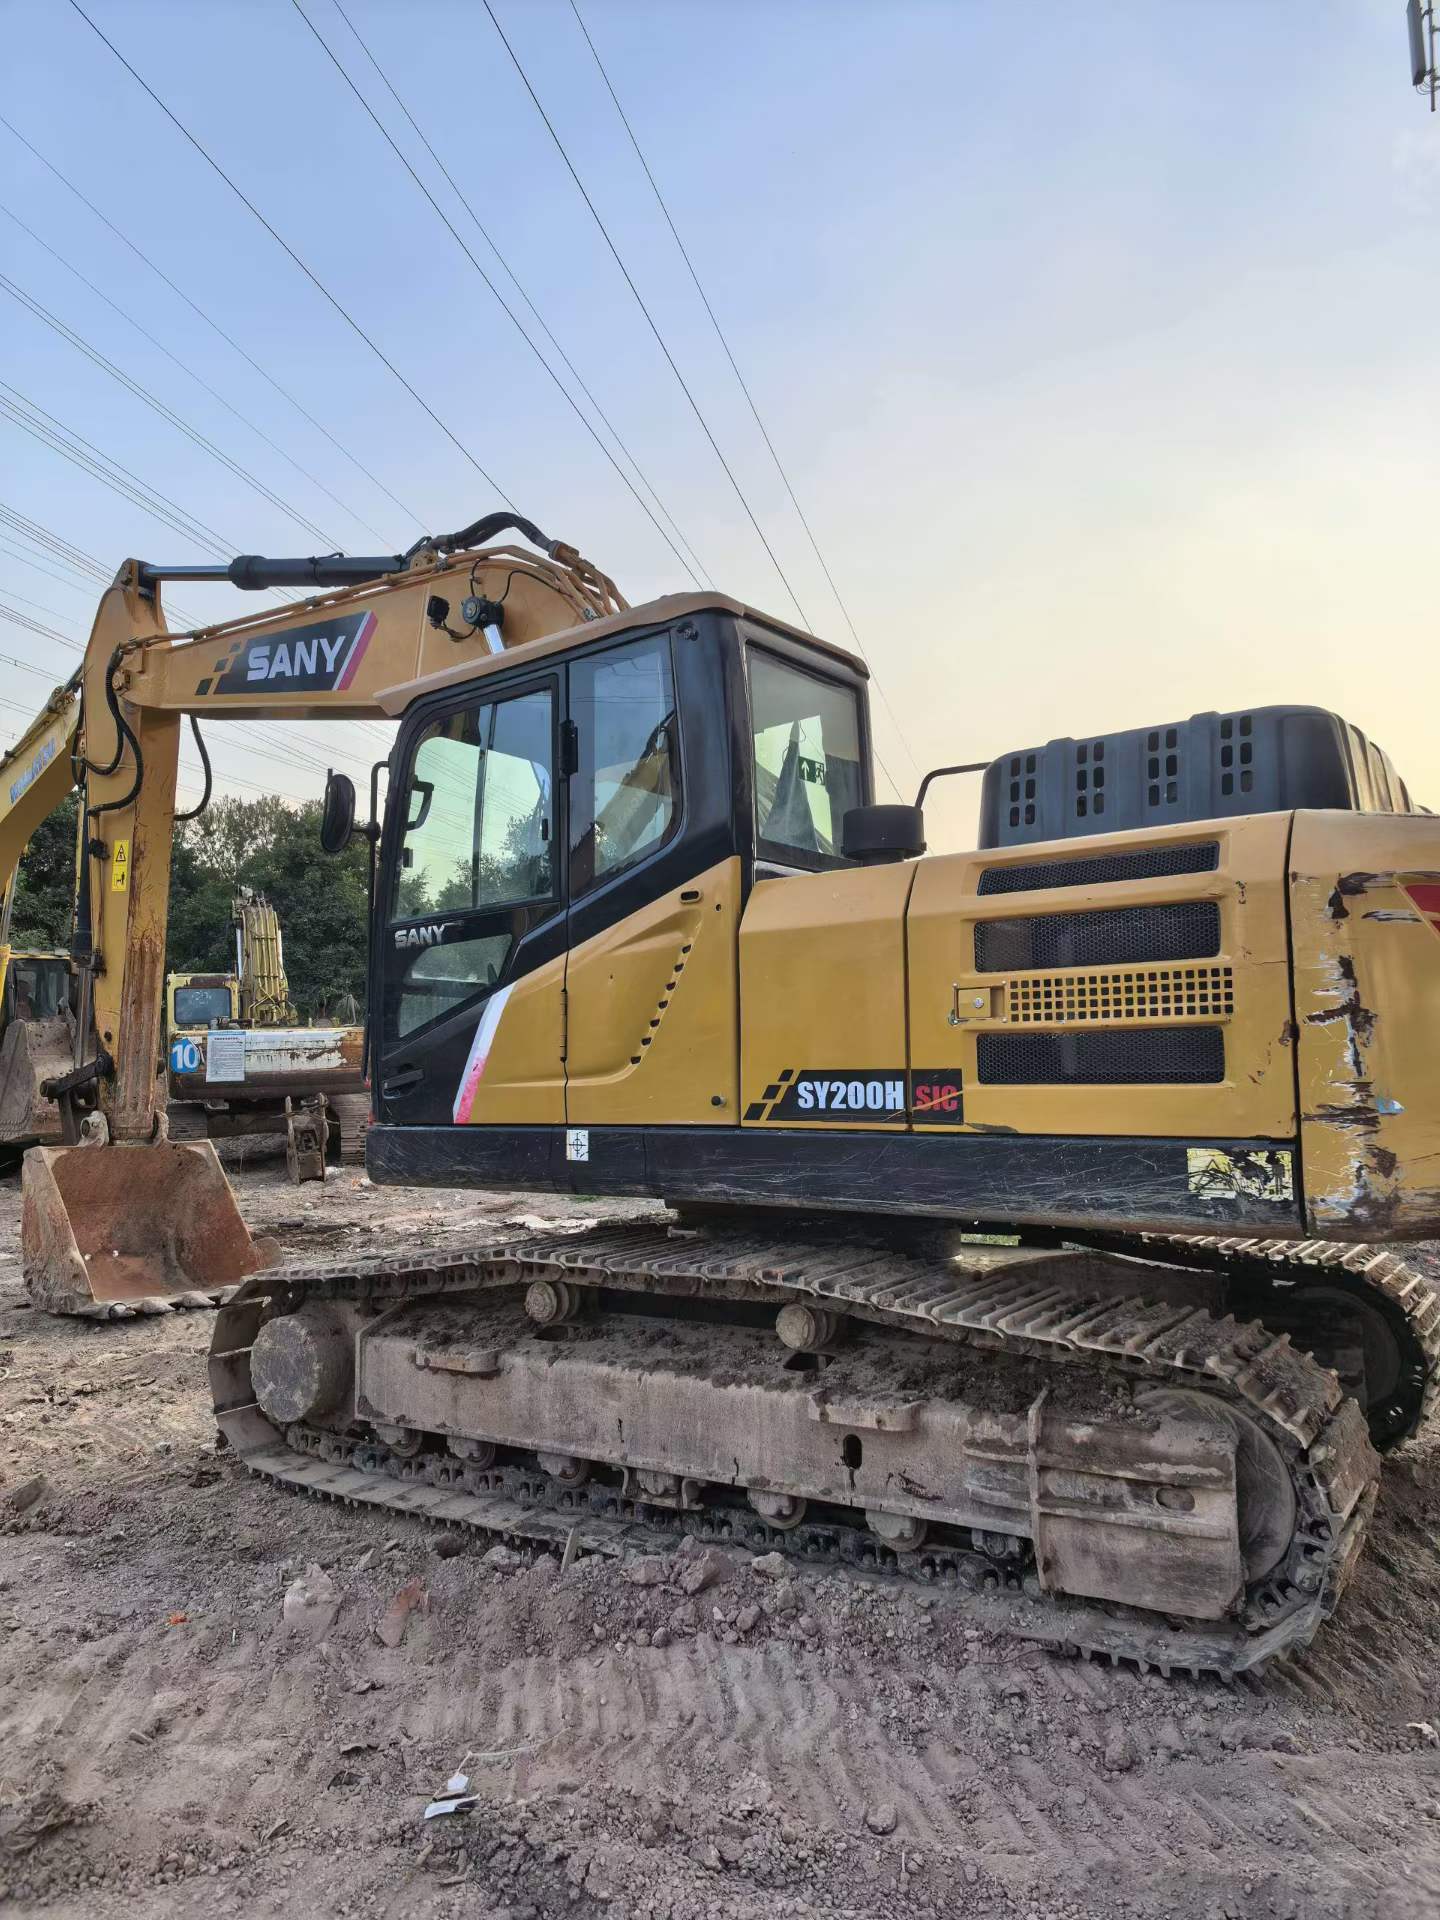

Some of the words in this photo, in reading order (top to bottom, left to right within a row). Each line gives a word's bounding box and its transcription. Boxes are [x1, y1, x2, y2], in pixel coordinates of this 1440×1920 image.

[247, 635, 346, 681] SANY
[394, 923, 445, 949] SANY
[172, 1044, 199, 1069] 10
[797, 1081, 905, 1110] SY200H
